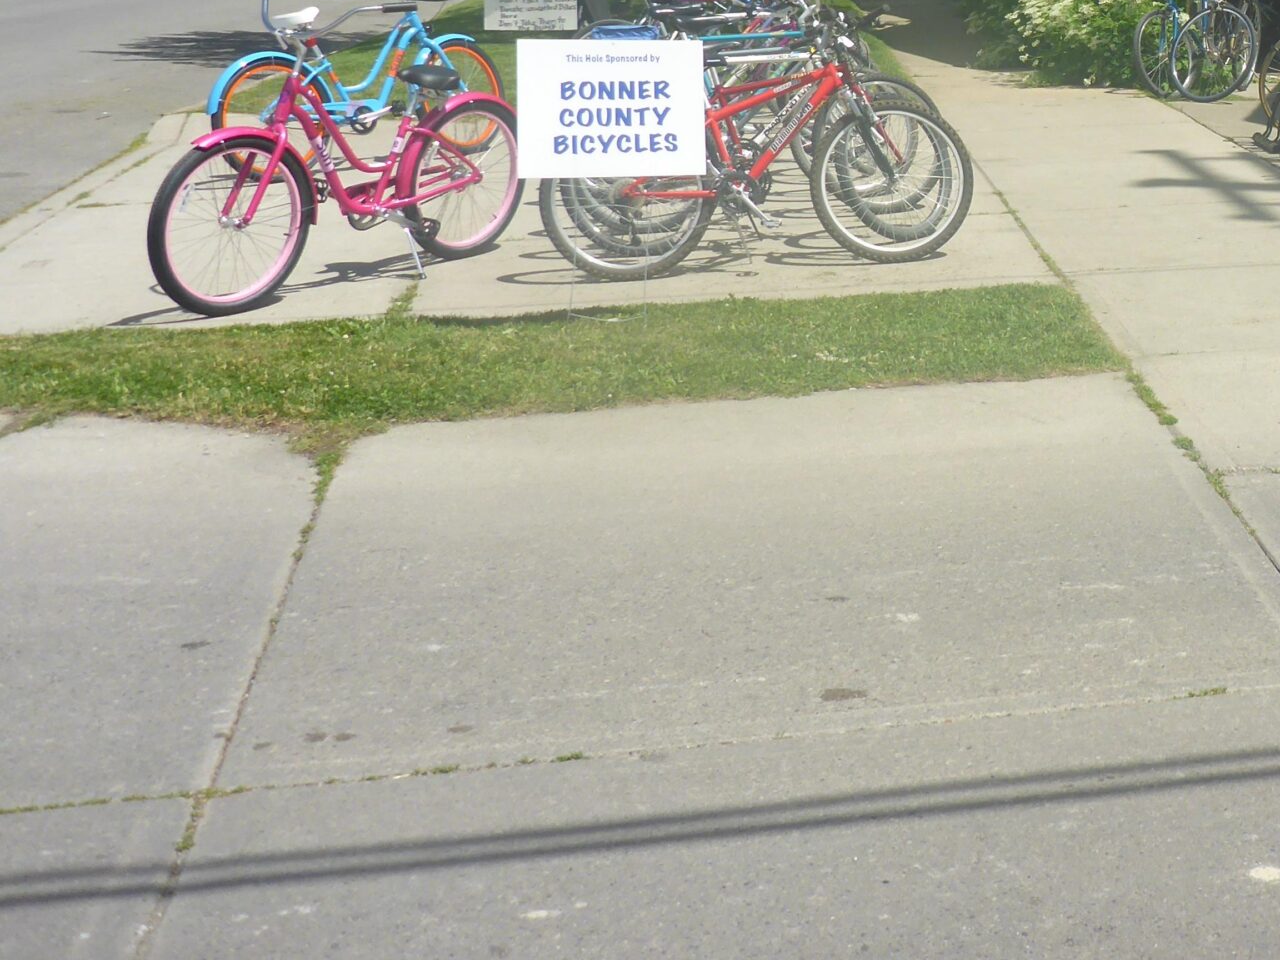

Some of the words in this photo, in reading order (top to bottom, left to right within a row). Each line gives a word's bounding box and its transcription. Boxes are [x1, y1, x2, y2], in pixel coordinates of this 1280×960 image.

[566, 54, 583, 63] This
[585, 54, 603, 63] Hole
[605, 54, 648, 64] Sponsored
[650, 54, 660, 64] by
[560, 80, 671, 101] BONNER
[559, 106, 671, 127] COUNTY
[553, 133, 678, 155] BICYCLES
